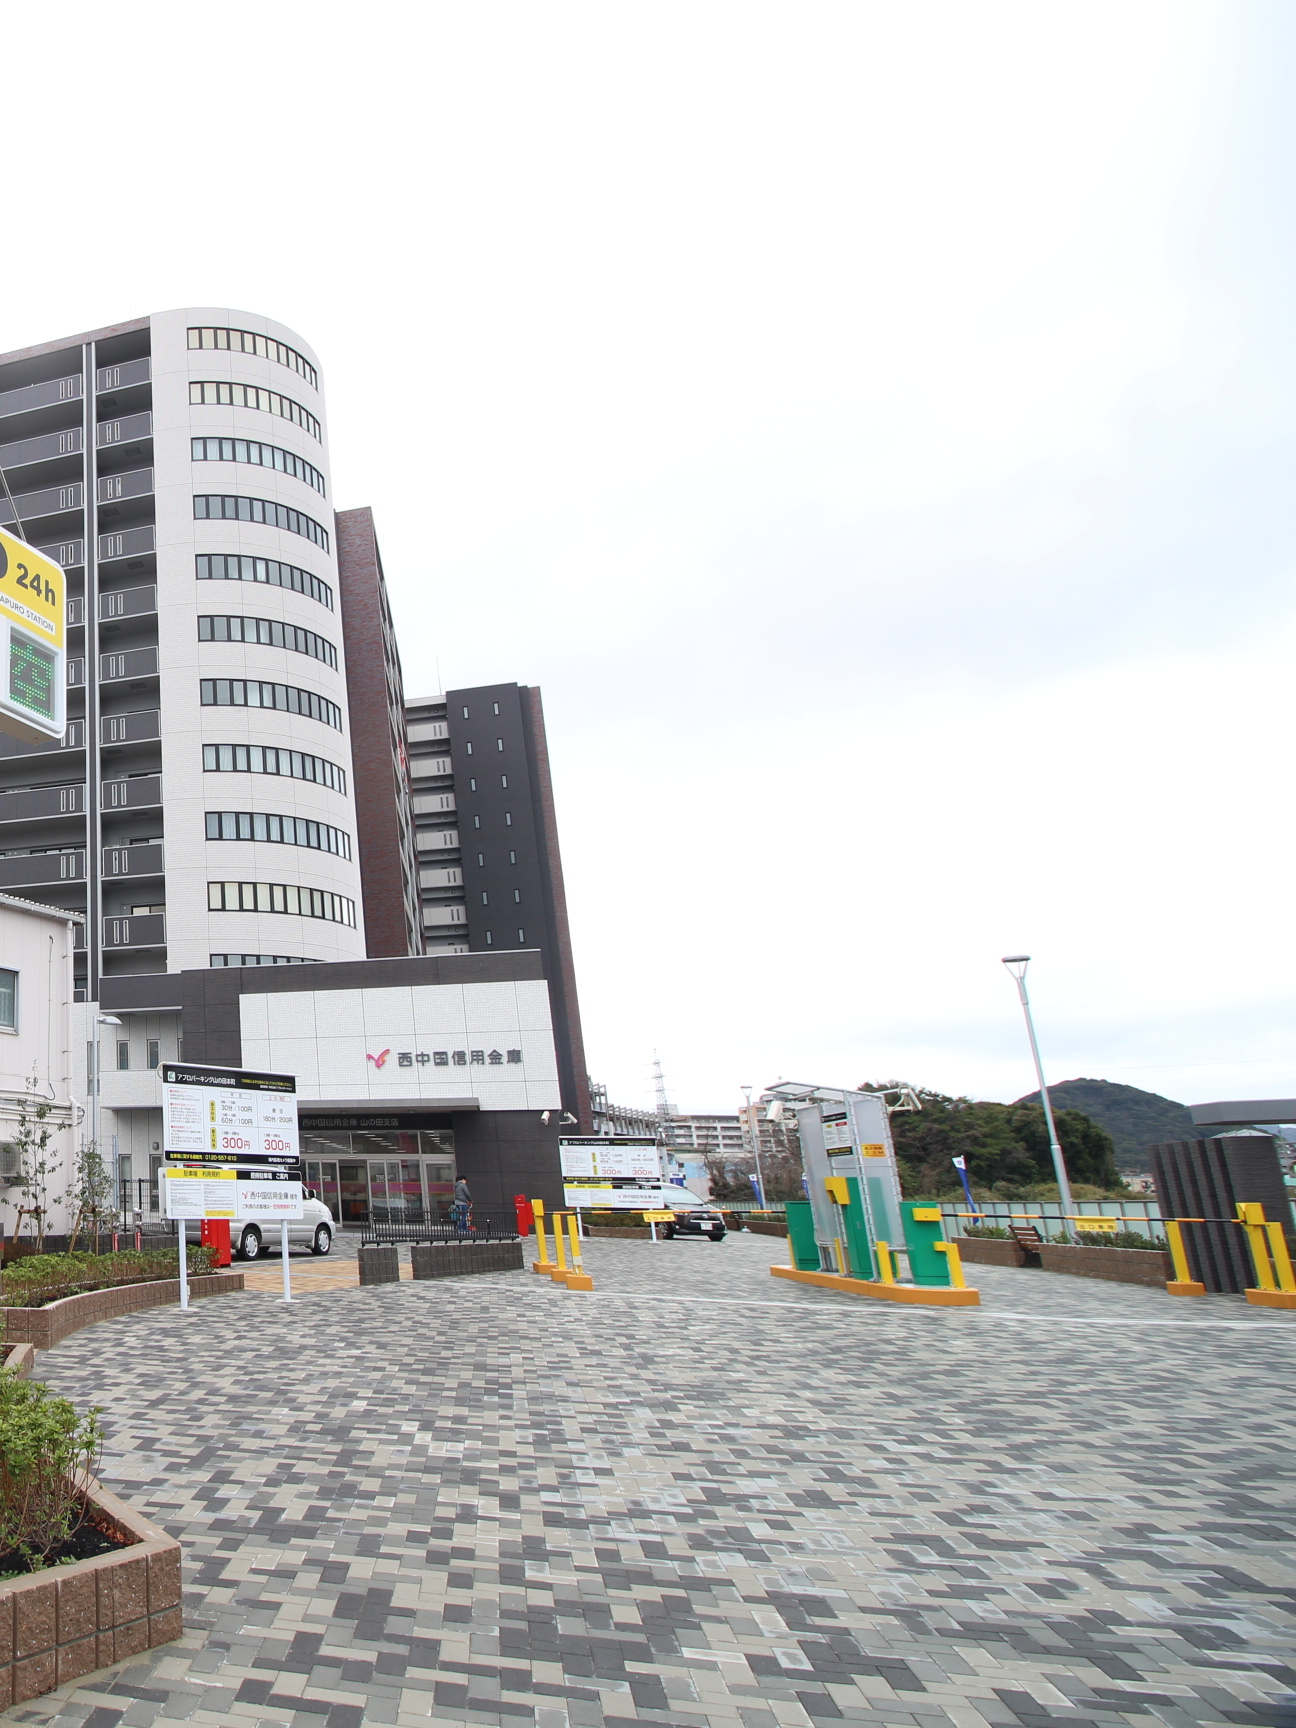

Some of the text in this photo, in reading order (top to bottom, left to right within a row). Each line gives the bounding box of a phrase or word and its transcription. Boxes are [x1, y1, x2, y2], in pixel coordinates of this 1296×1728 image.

[15, 562, 57, 608] 24h
[0, 594, 55, 634] APURO STATION
[397, 1049, 523, 1068] 西中国信用金庫
[302, 1118, 399, 1127] 西中国信用金庫 山の田支店
[222, 1137, 251, 1150] 300円
[264, 1138, 291, 1152] 300円
[249, 1191, 289, 1200] 西中国信用金庫
